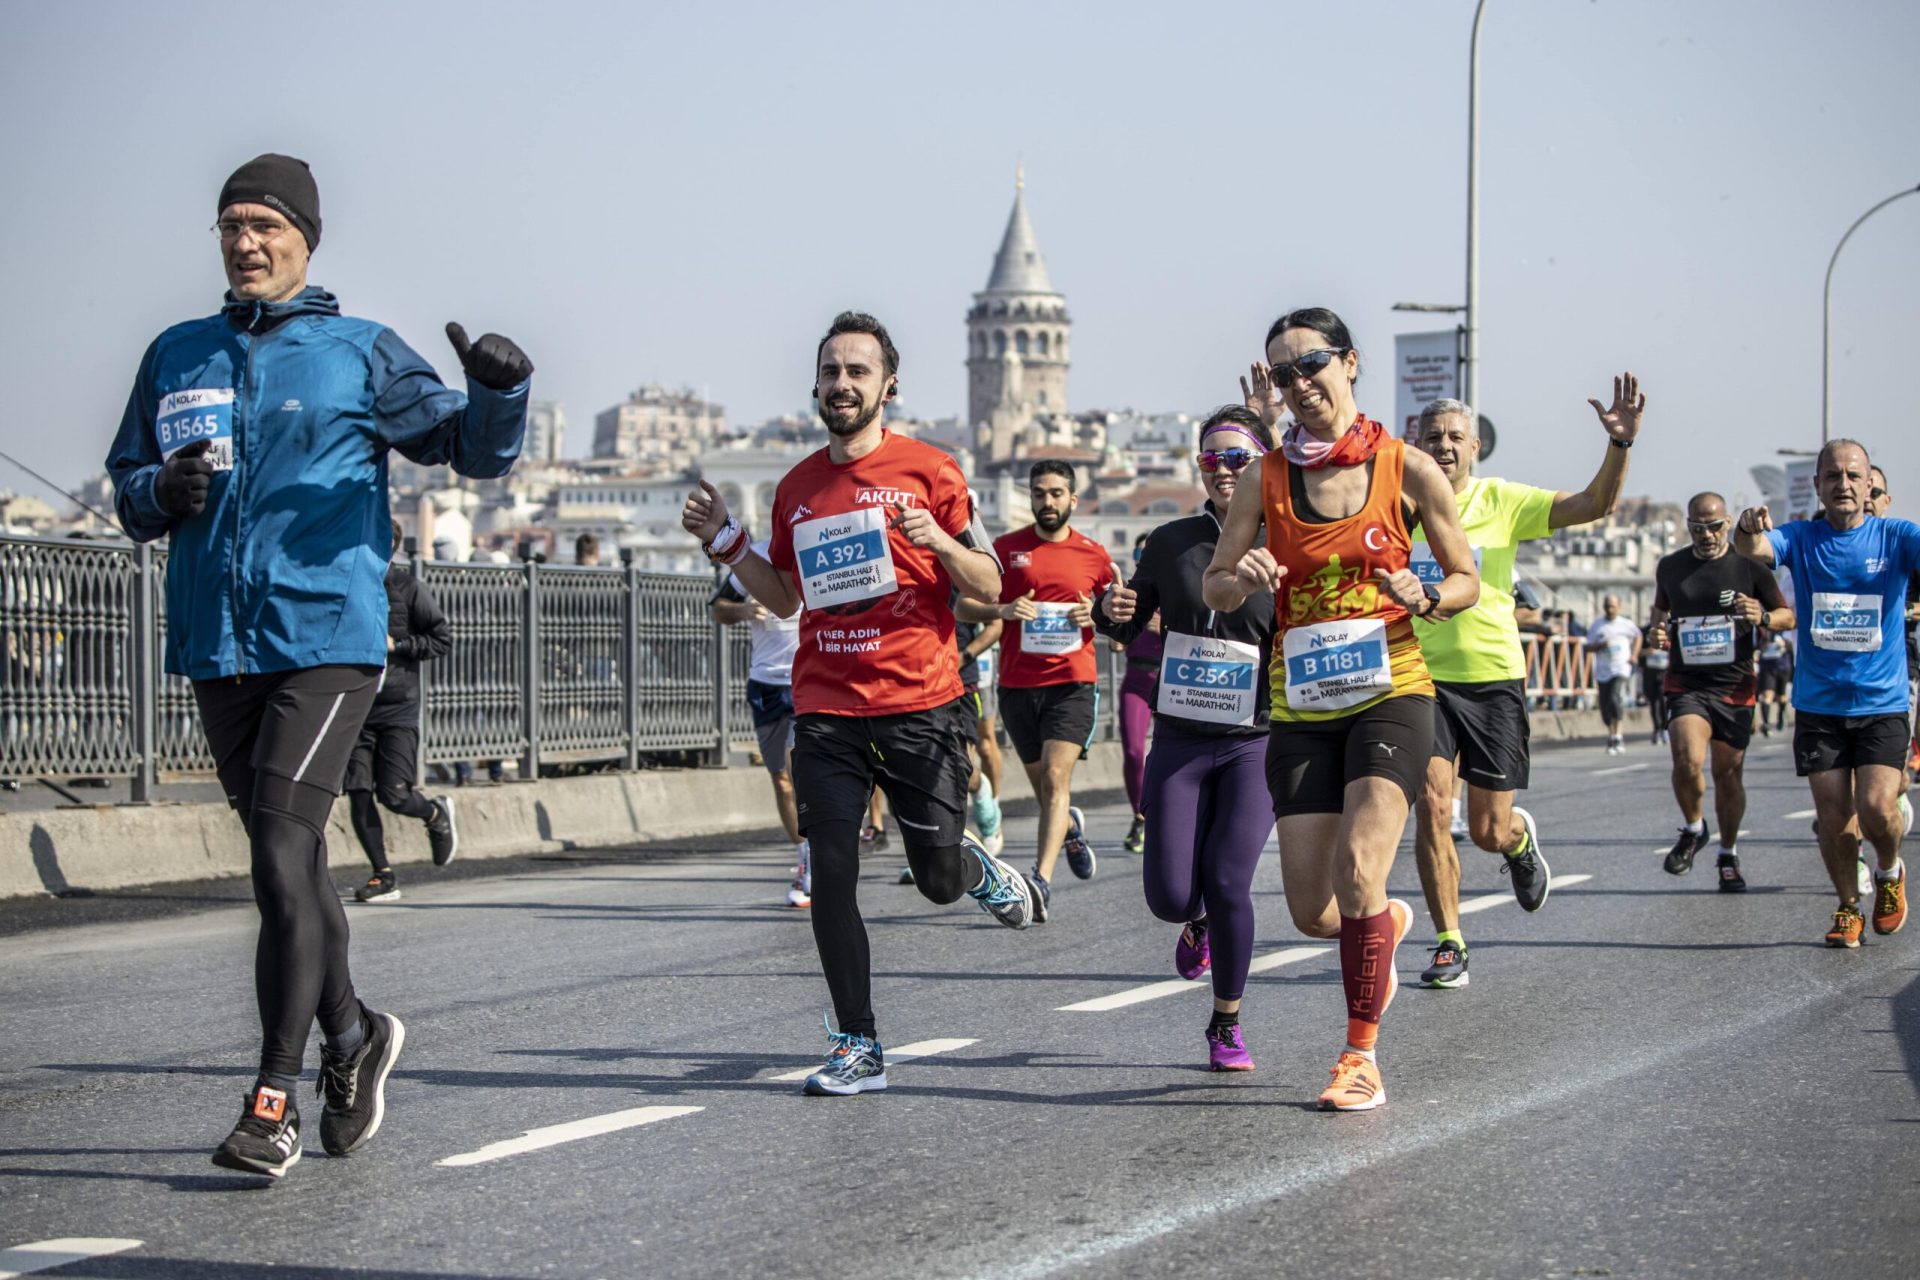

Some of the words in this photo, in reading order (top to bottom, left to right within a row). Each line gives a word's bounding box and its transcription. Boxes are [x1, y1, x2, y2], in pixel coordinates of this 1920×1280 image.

[161, 423, 171, 443] B
[174, 414, 218, 439] 1565
[858, 490, 912, 506] AKUT
[816, 551, 829, 568] A
[832, 543, 866, 563] 392
[856, 565, 873, 576] HALF
[1417, 565, 1426, 577] E
[1430, 566, 1446, 579] 4
[828, 575, 876, 592] MARATHON
[1032, 621, 1041, 630] C
[1823, 614, 1833, 625] C
[1837, 614, 1871, 626] 2027
[823, 630, 845, 639] HER
[848, 628, 880, 639] ADIM
[1698, 632, 1725, 643] 1045
[843, 641, 881, 653] HAYAT
[1304, 658, 1317, 676] B
[1322, 650, 1364, 672] 1181
[1177, 664, 1190, 680] C
[1195, 667, 1238, 687] 2561
[1350, 675, 1370, 684] HALF
[1219, 692, 1236, 701] HALF
[1185, 697, 1236, 711] MARATHON
